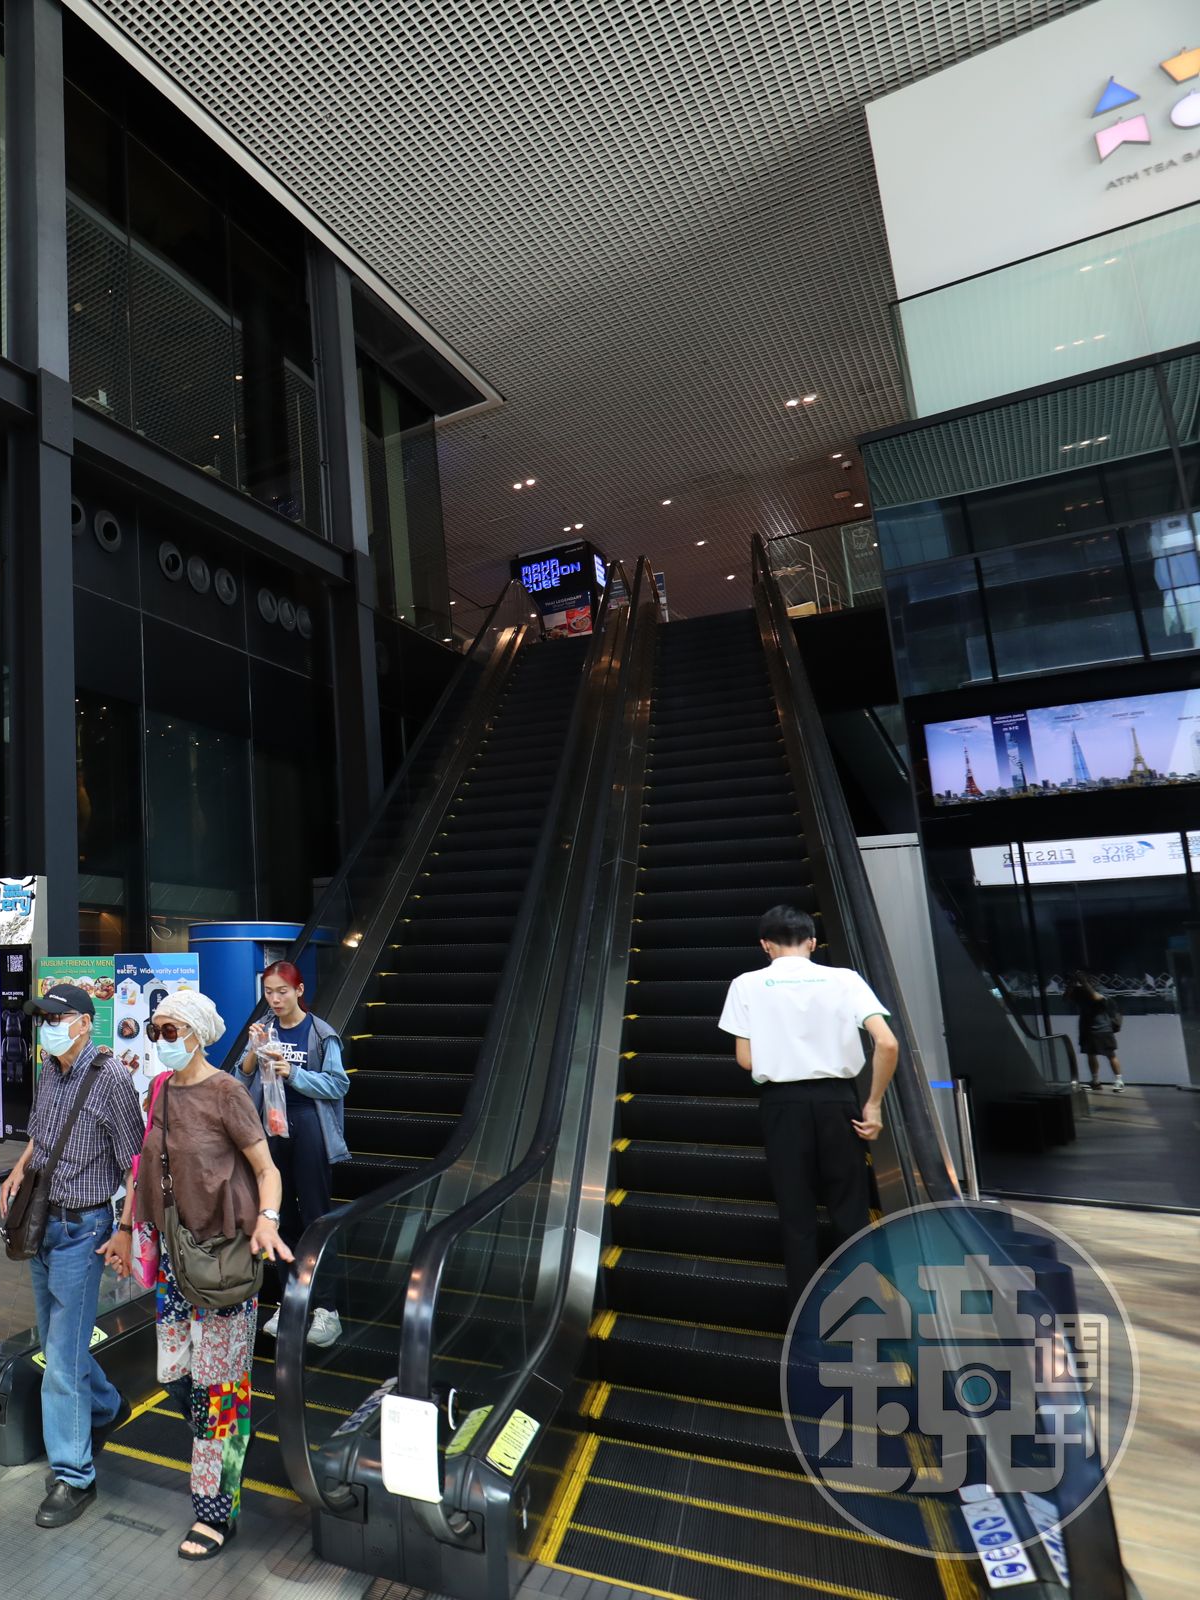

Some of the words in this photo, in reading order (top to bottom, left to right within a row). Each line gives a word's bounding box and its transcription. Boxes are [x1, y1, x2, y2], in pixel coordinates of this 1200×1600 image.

[1105, 171, 1139, 191] ATM
[1142, 159, 1178, 176] TEA
[521, 559, 559, 575] MAHA
[522, 562, 581, 585] NAKHON
[117, 964, 138, 976] eatery
[139, 967, 155, 975] Wide
[179, 967, 195, 975] taste
